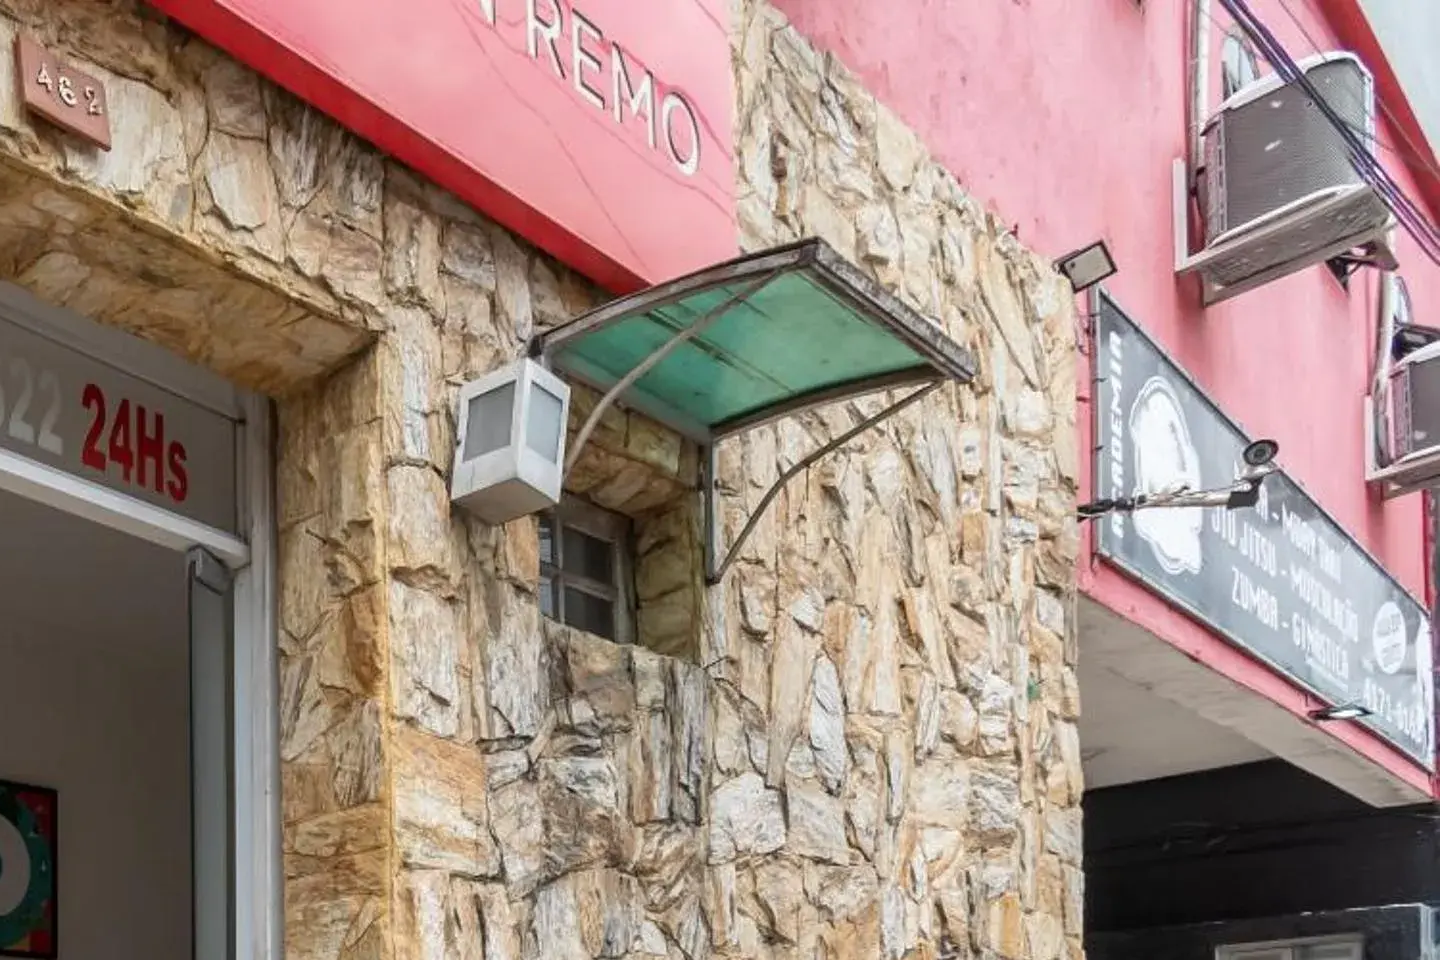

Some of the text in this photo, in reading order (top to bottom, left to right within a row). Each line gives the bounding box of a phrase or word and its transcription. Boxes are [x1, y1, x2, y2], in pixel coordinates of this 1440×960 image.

[37, 62, 103, 116] 462
[526, 0, 701, 176] REMO
[81, 383, 188, 503] 24Hs
[1239, 521, 1277, 578] JITSU
[1231, 564, 1279, 632] ZUMBA
